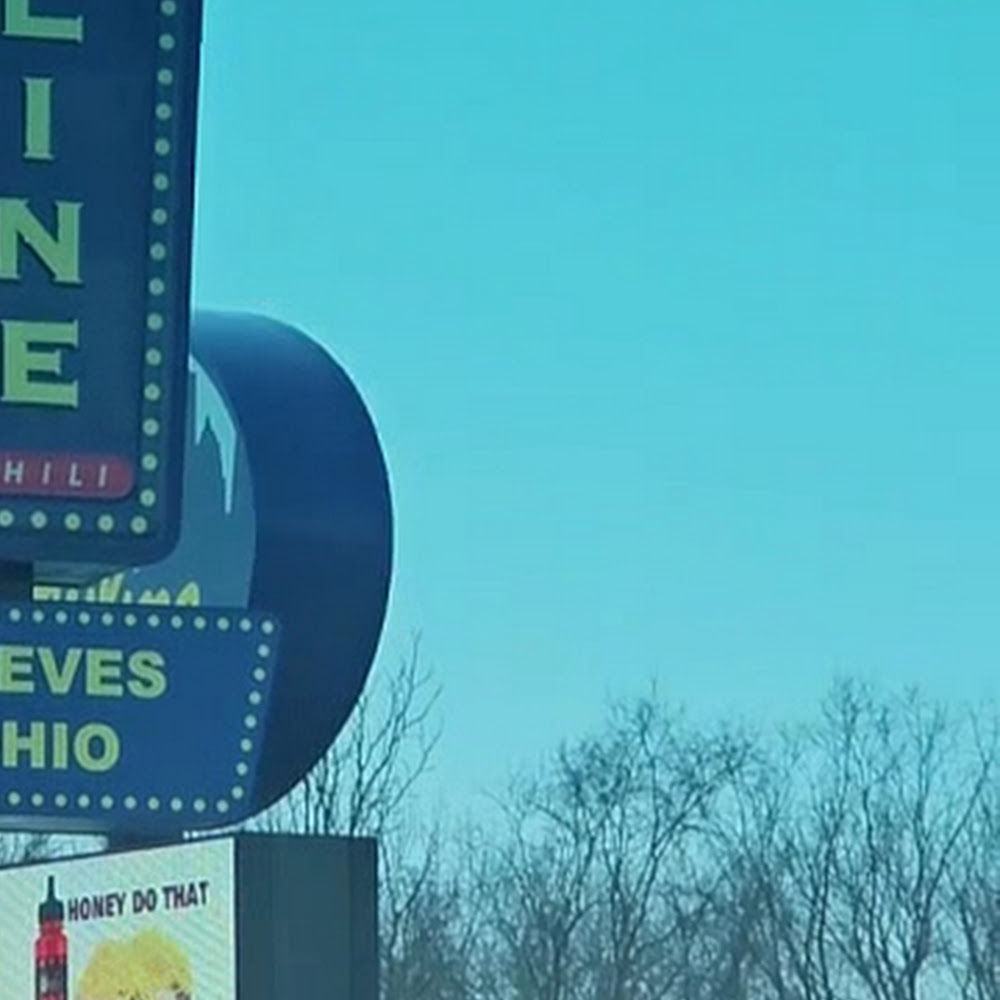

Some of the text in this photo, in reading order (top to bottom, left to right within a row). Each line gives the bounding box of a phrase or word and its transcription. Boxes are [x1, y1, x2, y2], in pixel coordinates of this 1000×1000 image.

[67, 881, 209, 921] HONEY DO THAT
